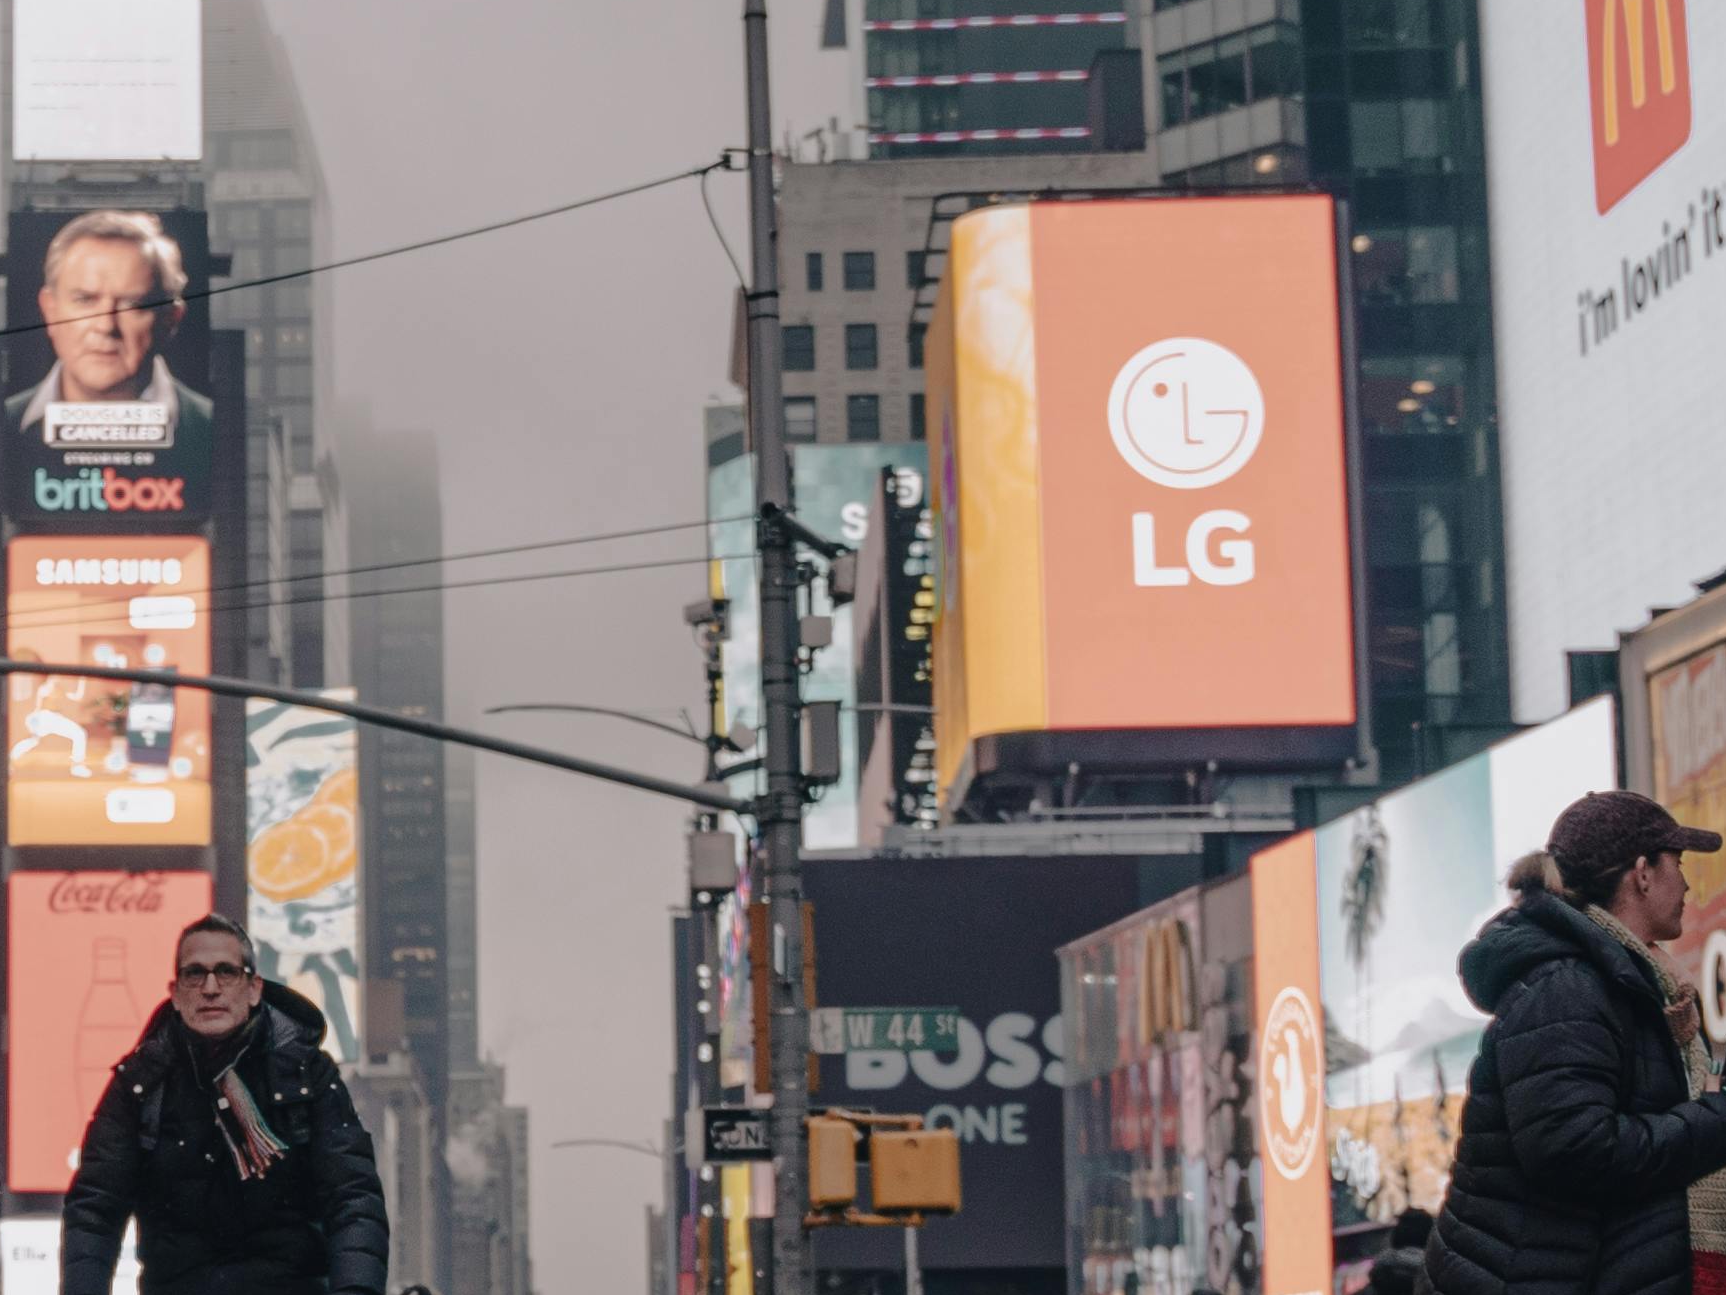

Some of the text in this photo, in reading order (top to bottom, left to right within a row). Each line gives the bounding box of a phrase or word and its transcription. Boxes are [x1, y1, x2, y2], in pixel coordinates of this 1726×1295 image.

[1577, 287, 1617, 359] i'm
[1621, 204, 1696, 324] lovin'
[59, 424, 165, 442] CANCELLED
[34, 466, 186, 512] britbox
[1131, 509, 1256, 587] LG
[35, 558, 182, 586] SAMSUNG
[850, 1014, 875, 1048] W
[887, 1013, 925, 1047] 44
[924, 1103, 1028, 1145] ONE
